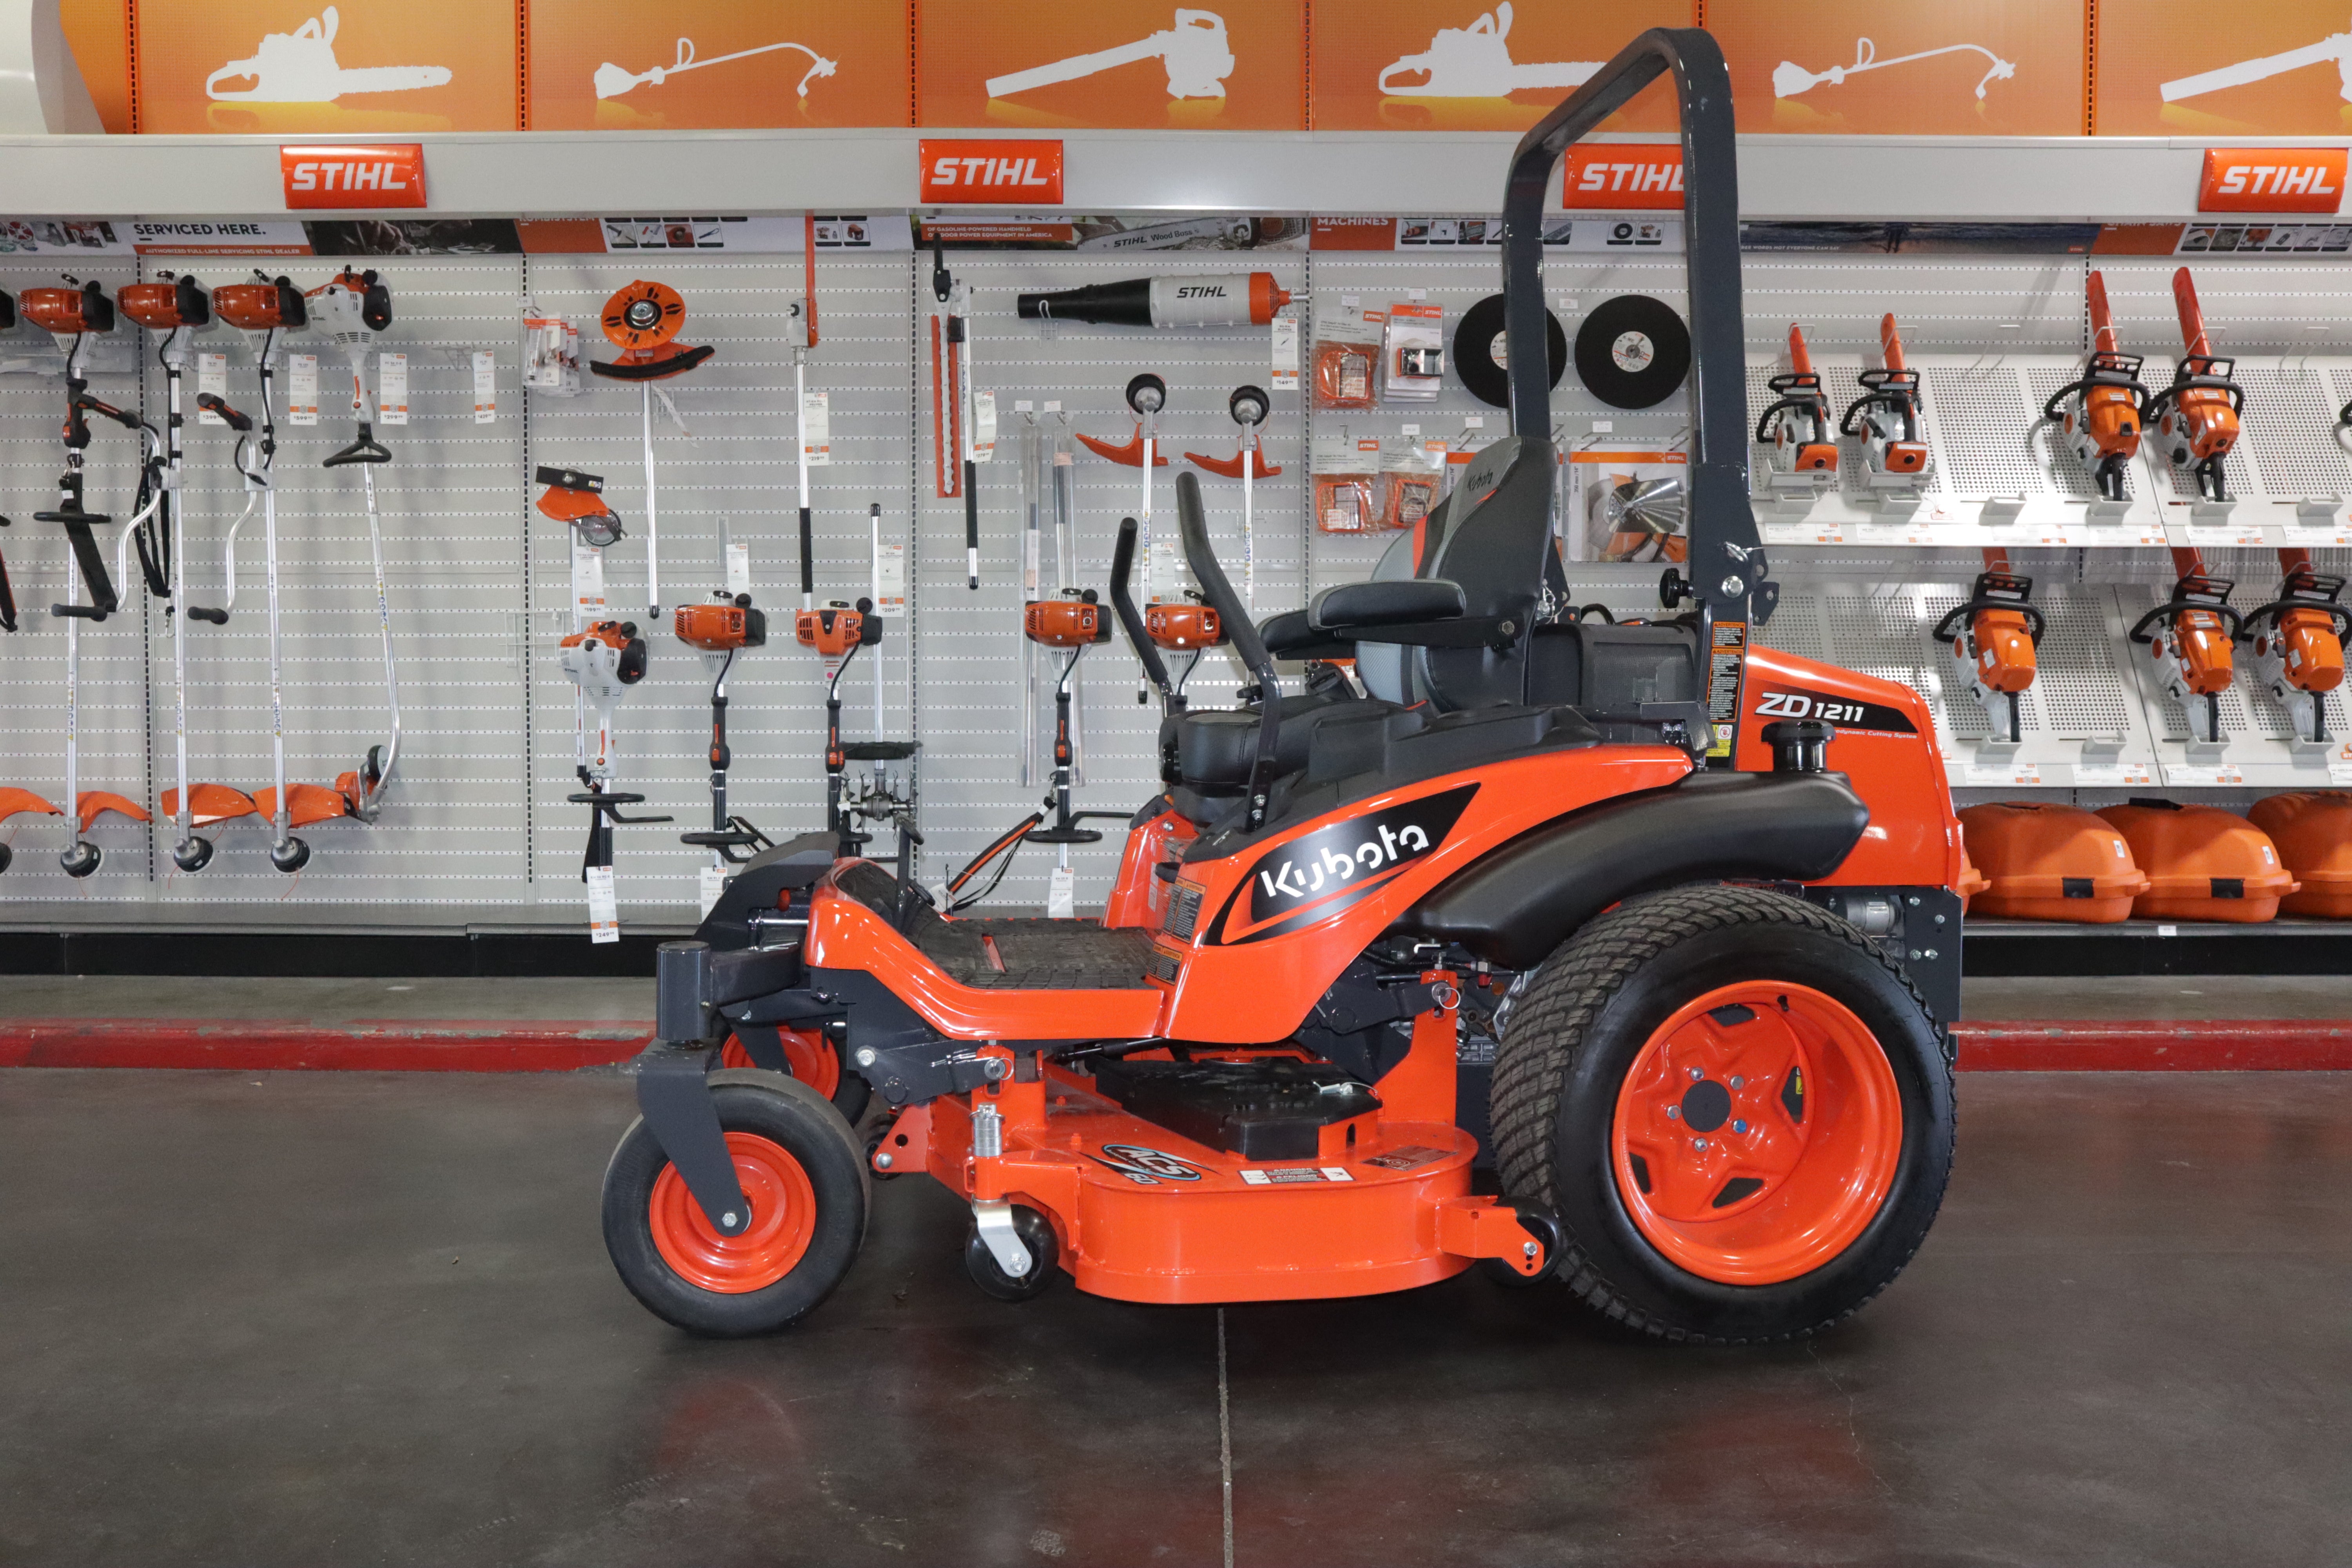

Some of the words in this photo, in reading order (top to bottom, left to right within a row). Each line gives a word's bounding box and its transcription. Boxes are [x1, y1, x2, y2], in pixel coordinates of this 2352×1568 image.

[292, 162, 407, 190] STIHL
[931, 158, 1048, 185] STIHL
[1578, 163, 1684, 191] STIHL
[2218, 166, 2335, 194] STIHL
[133, 224, 212, 235] SERVICED
[217, 224, 266, 235] HERE.
[1317, 218, 1388, 226] MACHINES
[1114, 236, 1147, 247] STIHL
[1151, 232, 1173, 241] Wood
[1174, 229, 1193, 238] Boss
[1177, 286, 1227, 298] STIHL
[1467, 468, 1493, 491] Kubota
[1755, 691, 1811, 718] ZD
[1814, 702, 1864, 722] 1211
[1260, 825, 1429, 898] Kubota
[1117, 1149, 1196, 1174] ACS
[1124, 1173, 1159, 1184] 60
